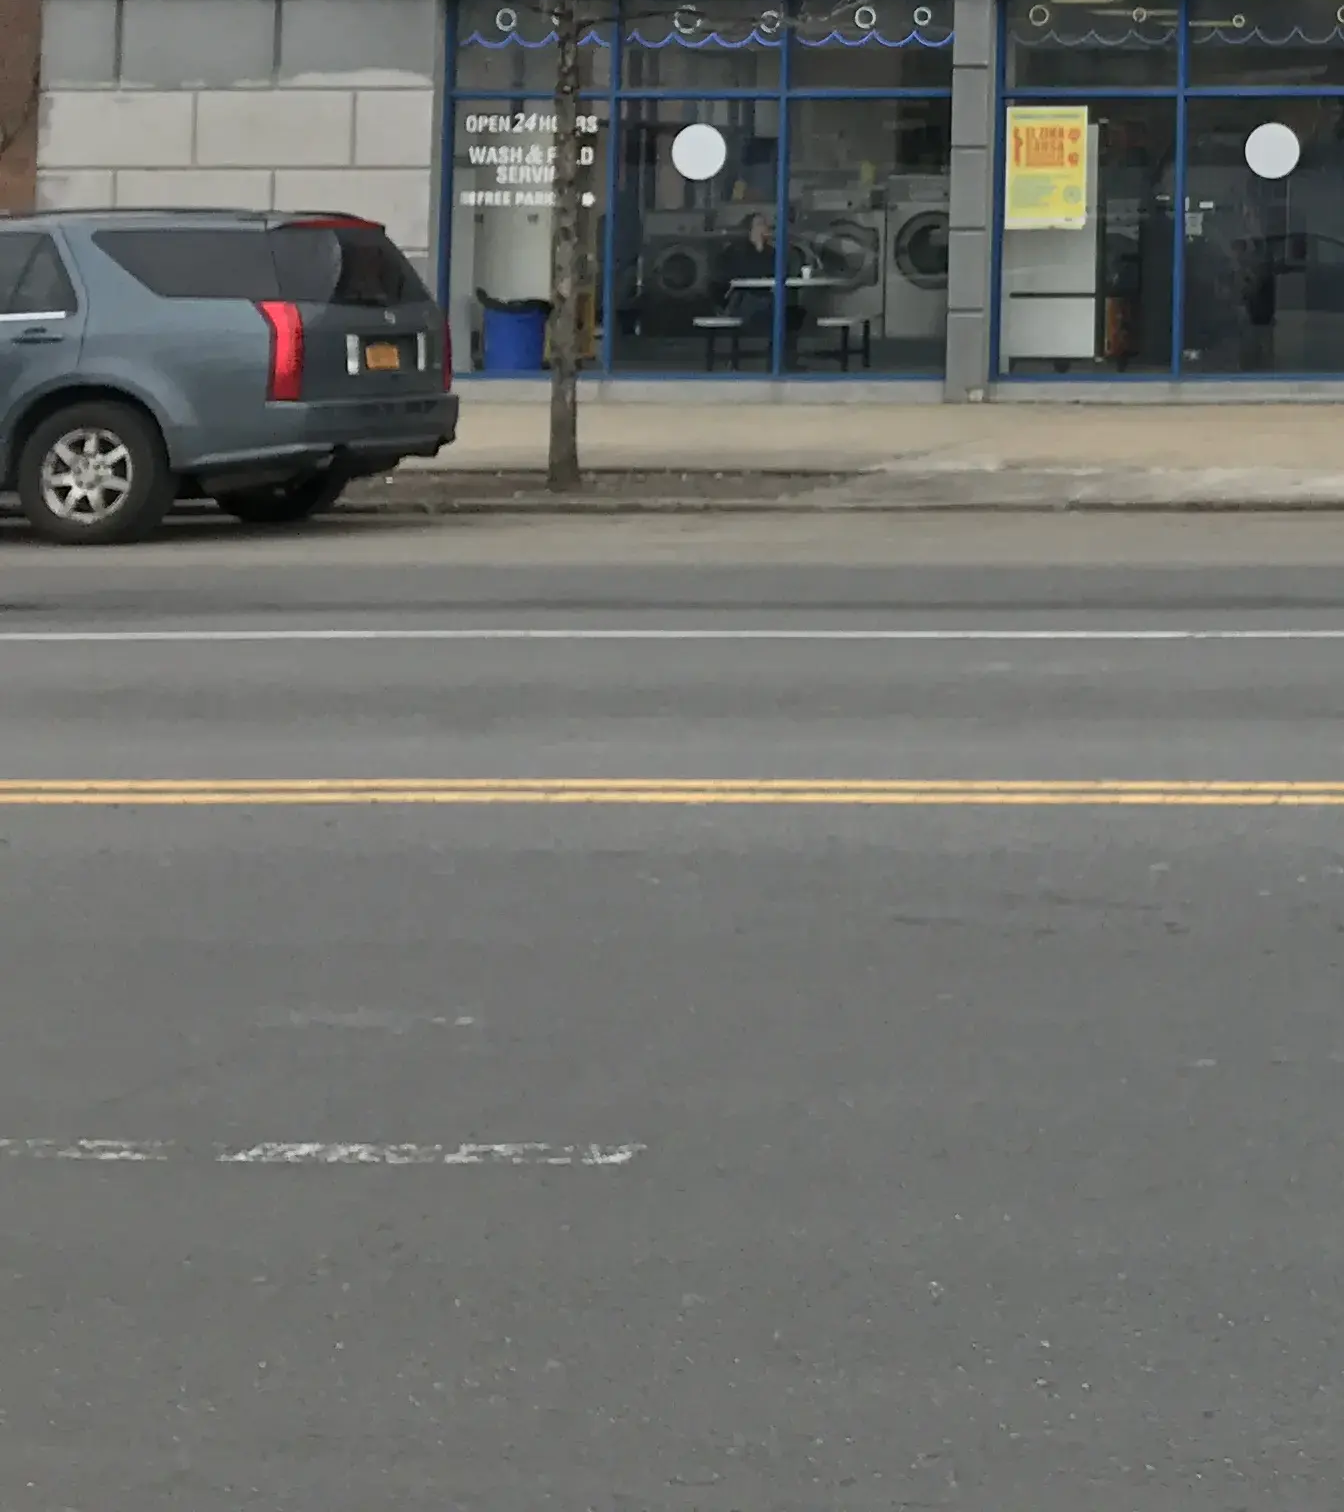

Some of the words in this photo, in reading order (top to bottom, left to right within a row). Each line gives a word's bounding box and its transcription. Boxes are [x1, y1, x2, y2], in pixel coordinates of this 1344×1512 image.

[466, 114, 511, 133] OPEN
[512, 113, 537, 134] 24
[539, 114, 599, 133] HRS
[468, 145, 523, 165] WASH
[547, 146, 594, 165] FD
[496, 165, 556, 184] SERVI
[477, 191, 512, 206] FREE
[515, 191, 580, 206] PARK
